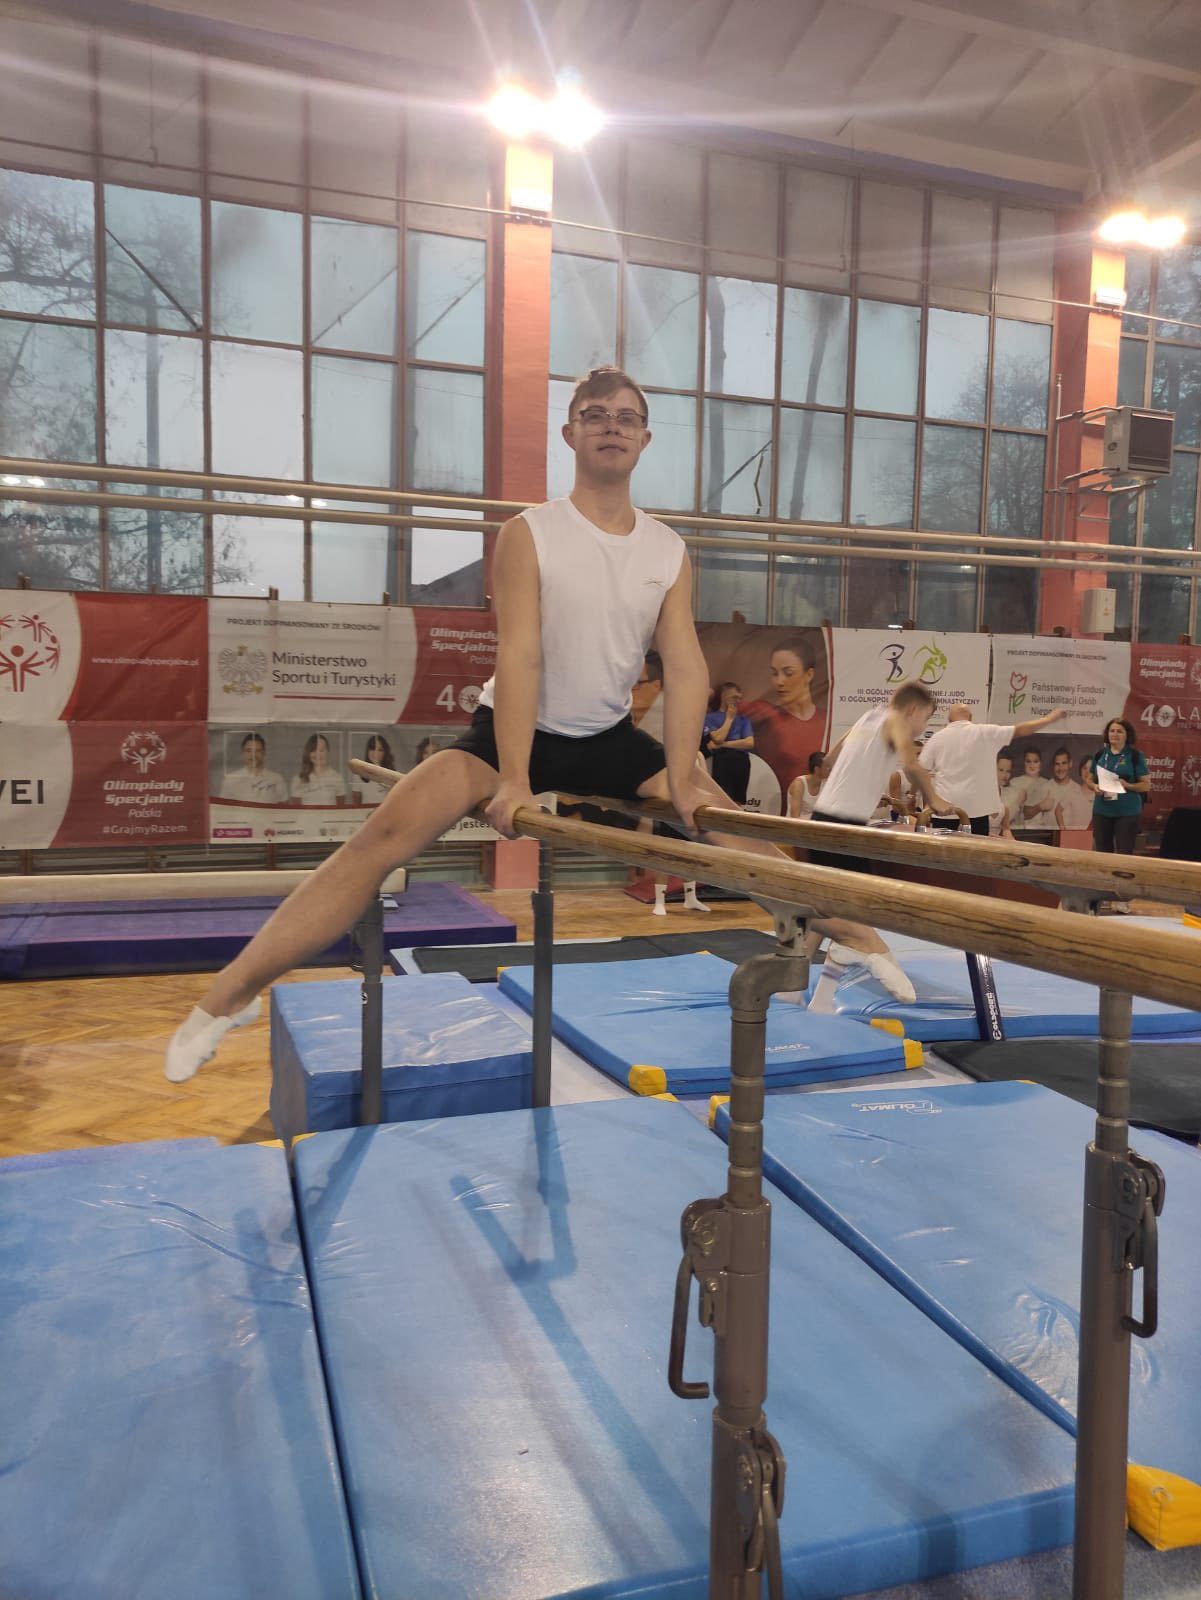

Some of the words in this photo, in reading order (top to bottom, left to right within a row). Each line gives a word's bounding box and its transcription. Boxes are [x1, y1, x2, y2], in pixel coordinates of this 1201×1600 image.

[272, 651, 367, 668] Ministerstwo
[272, 669, 320, 685] Sportu
[323, 672, 328, 684] i
[330, 671, 397, 688] Turystyki
[1031, 682, 1075, 694] Państwowy
[1076, 684, 1106, 694] Fundusz
[1031, 694, 1077, 706] Rehabilitacji
[1078, 696, 1097, 706] Osób
[103, 780, 185, 792] Olimpiady
[104, 793, 184, 806] Specjalne
[128, 808, 162, 818] Polska
[103, 823, 188, 835] #GrajmyRazem
